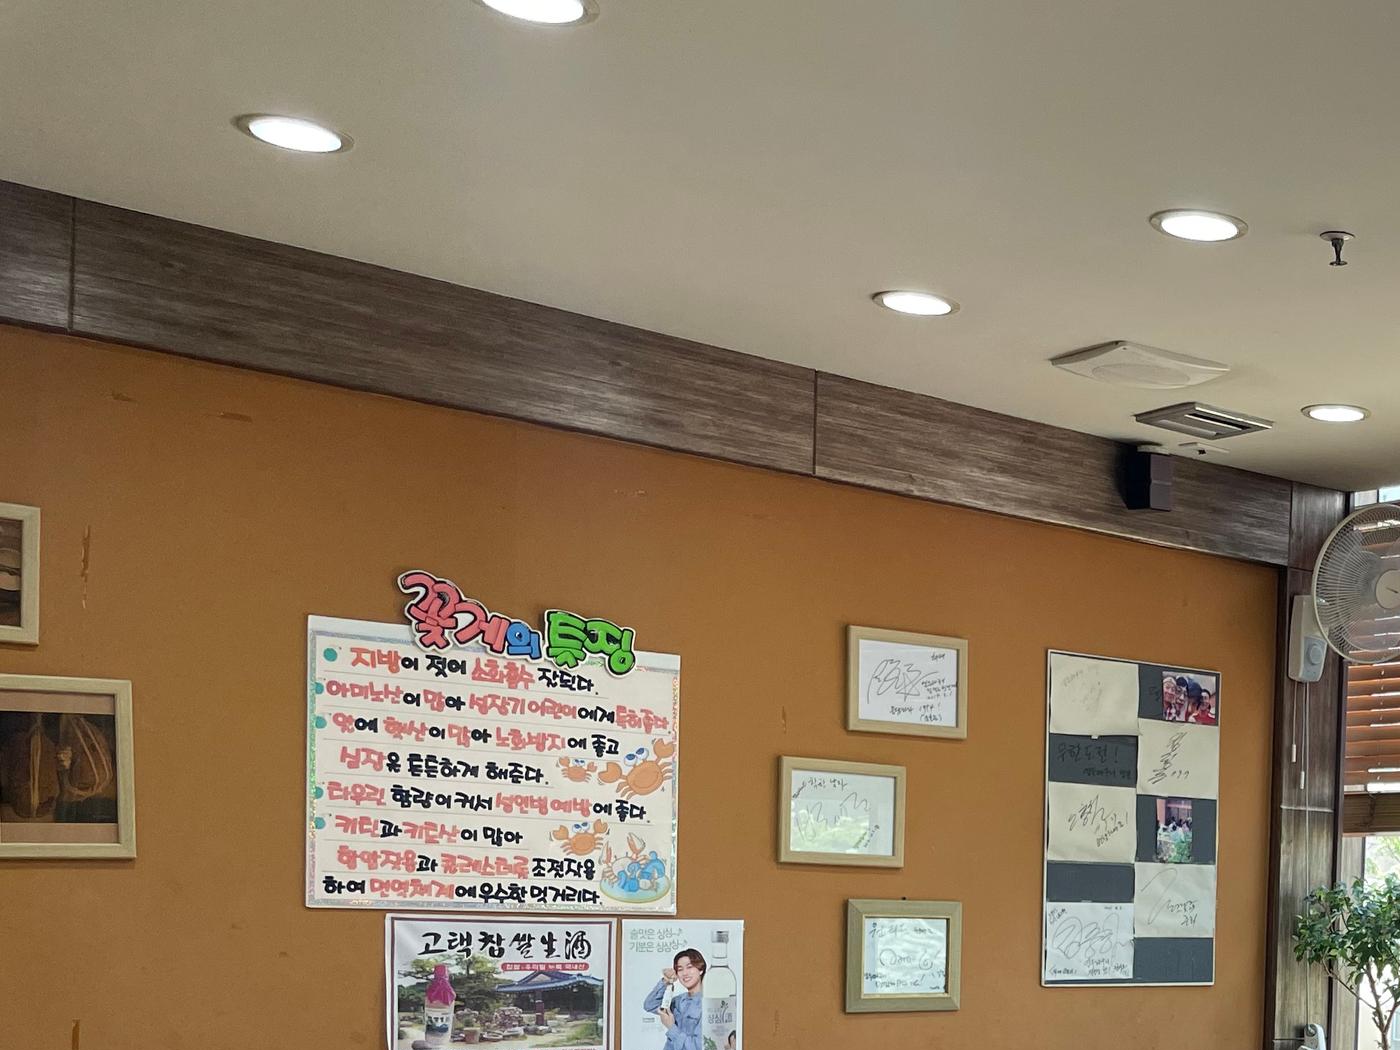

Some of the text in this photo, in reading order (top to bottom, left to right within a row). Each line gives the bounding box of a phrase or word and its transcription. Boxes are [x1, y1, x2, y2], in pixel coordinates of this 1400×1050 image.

[399, 571, 636, 676] 꽃게의 특징
[350, 647, 419, 674] 지방이
[326, 680, 421, 707] 아미노산이
[423, 689, 466, 712] 많아
[469, 693, 525, 716] 성장기
[527, 698, 615, 724] 어린이에게
[448, 723, 492, 748] 많아
[496, 727, 587, 752] 노화방지에
[591, 734, 620, 758] 좋고
[340, 746, 549, 785] 심장을 튼튼하게 해준다.
[326, 781, 651, 823] 타우린 함량이 커서 성인병 예방에 좋다.
[335, 815, 402, 838] 키틴과
[483, 826, 523, 846] 많아
[337, 845, 438, 873] 항암작용과
[532, 857, 596, 880] 조절작용
[323, 876, 366, 895] 하여
[369, 878, 476, 899] 면역체계에
[478, 882, 527, 904] 우수한
